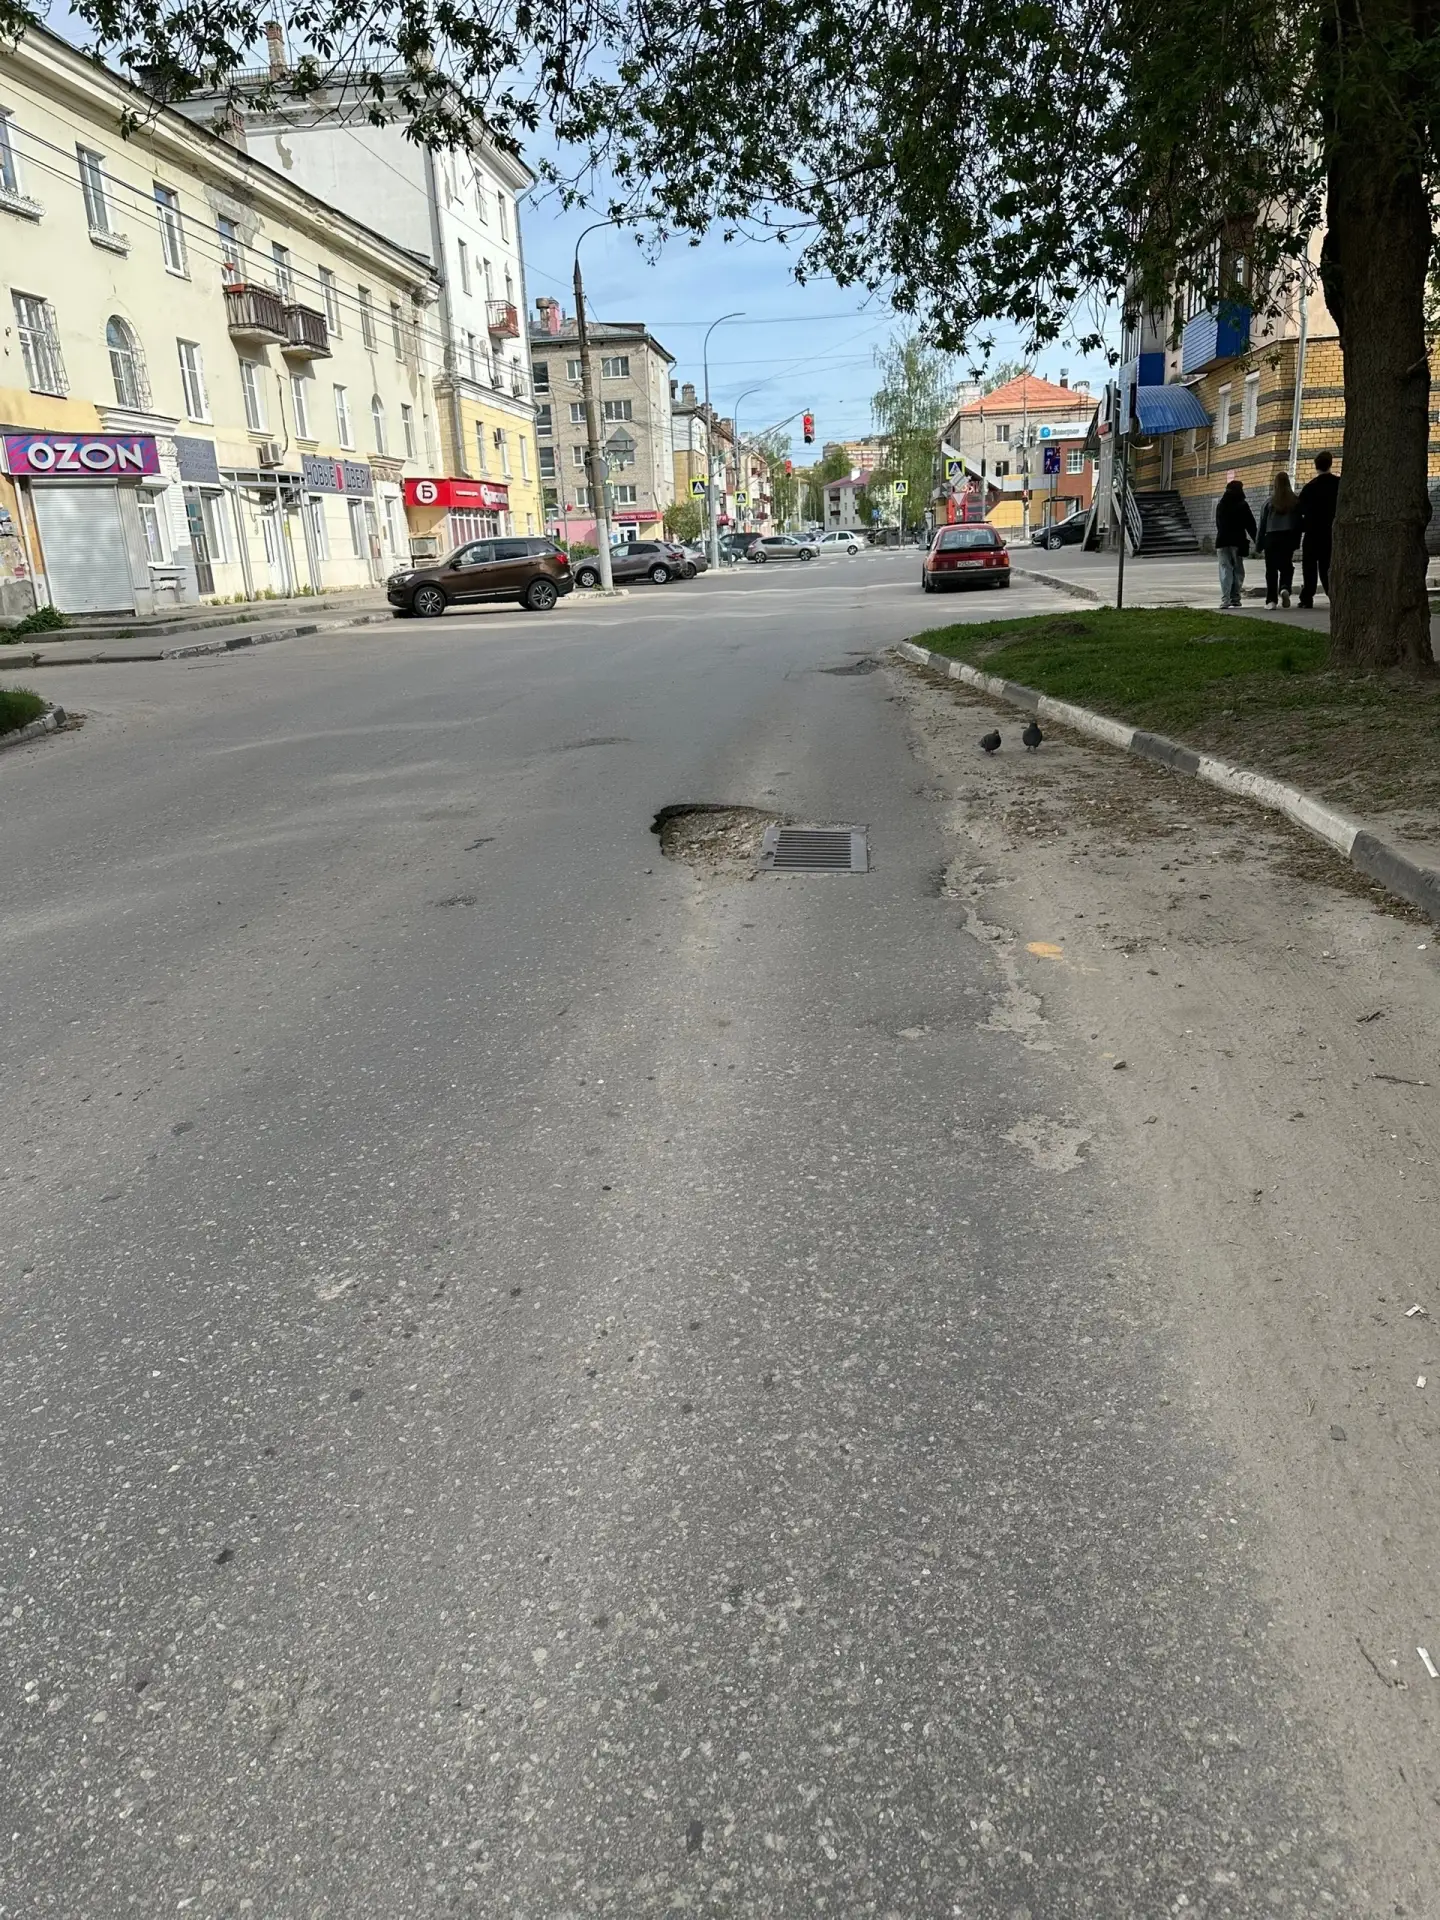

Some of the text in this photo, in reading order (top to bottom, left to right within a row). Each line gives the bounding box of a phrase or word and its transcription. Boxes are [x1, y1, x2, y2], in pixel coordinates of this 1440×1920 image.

[27, 442, 144, 470] OZON
[304, 462, 370, 490] НОВЫЕ ДВЕРИ
[421, 484, 433, 499] Б
